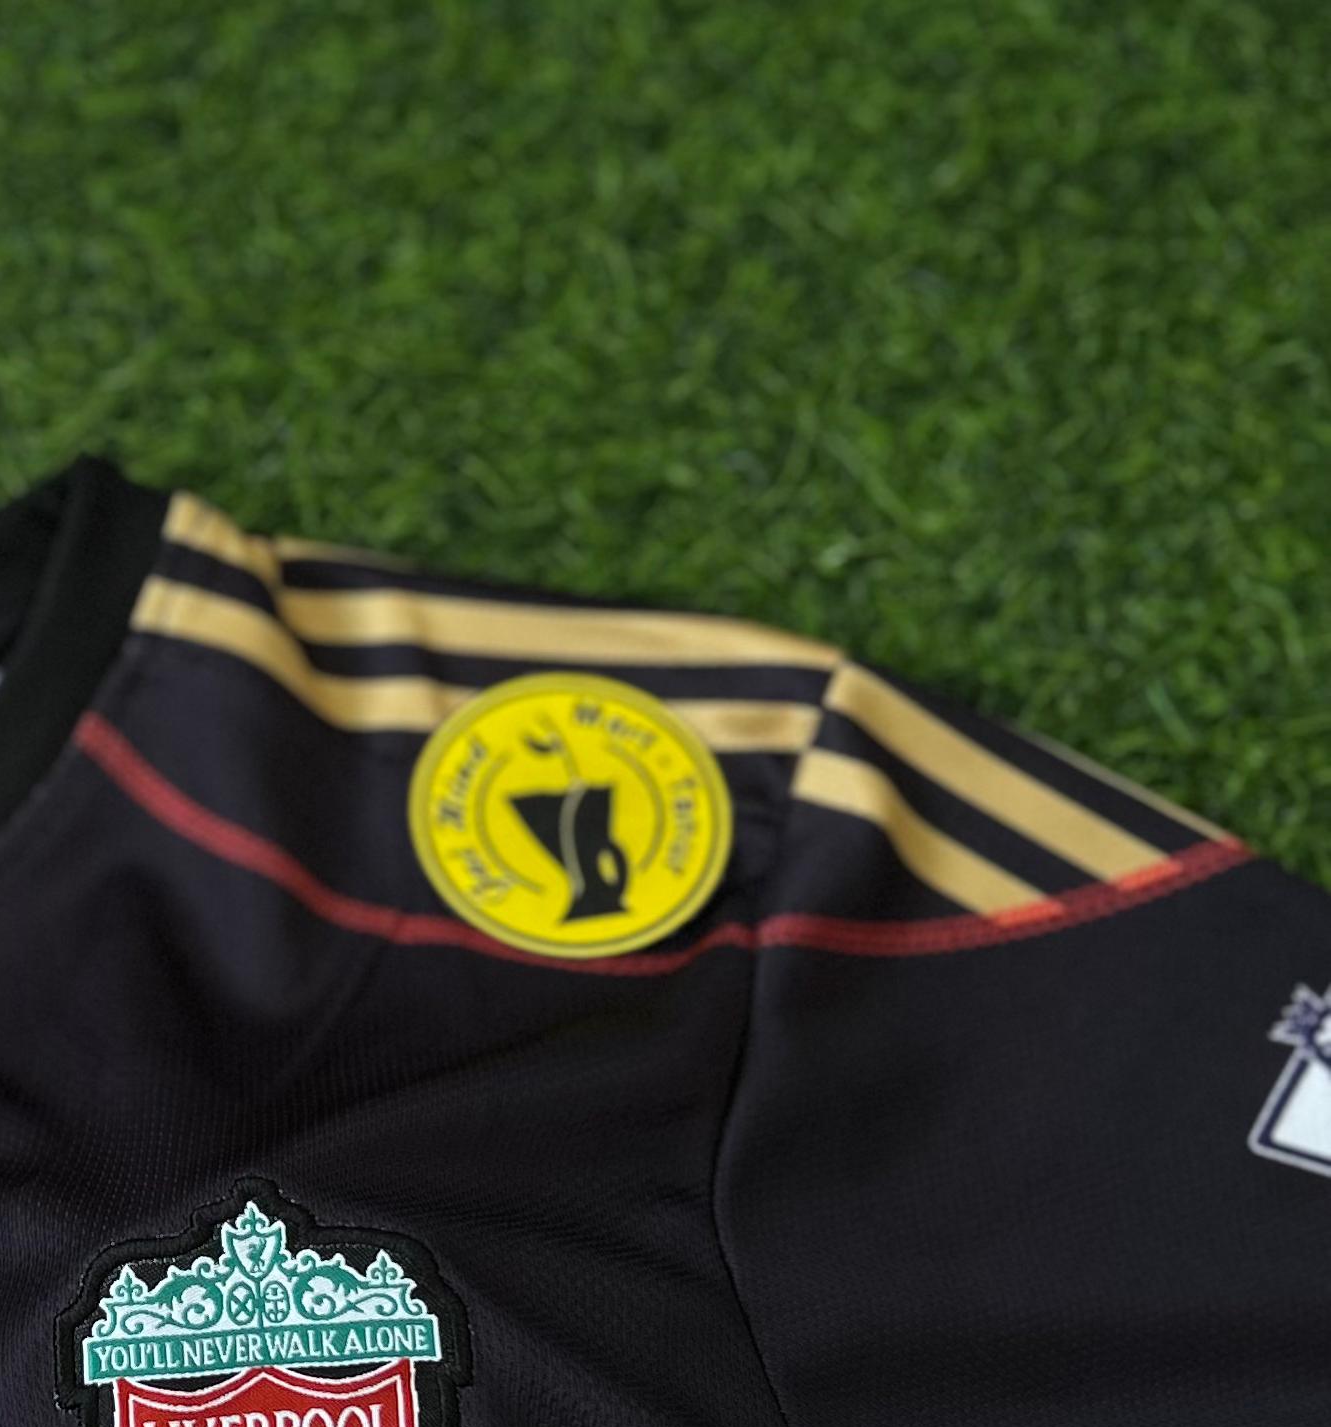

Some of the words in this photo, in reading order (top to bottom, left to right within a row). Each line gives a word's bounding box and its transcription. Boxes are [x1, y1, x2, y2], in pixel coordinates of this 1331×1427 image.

[92, 1342, 181, 1374] YOU'LL
[182, 1332, 264, 1370] NEVER
[265, 1329, 337, 1362] WALK
[342, 1323, 429, 1357] ALONE
